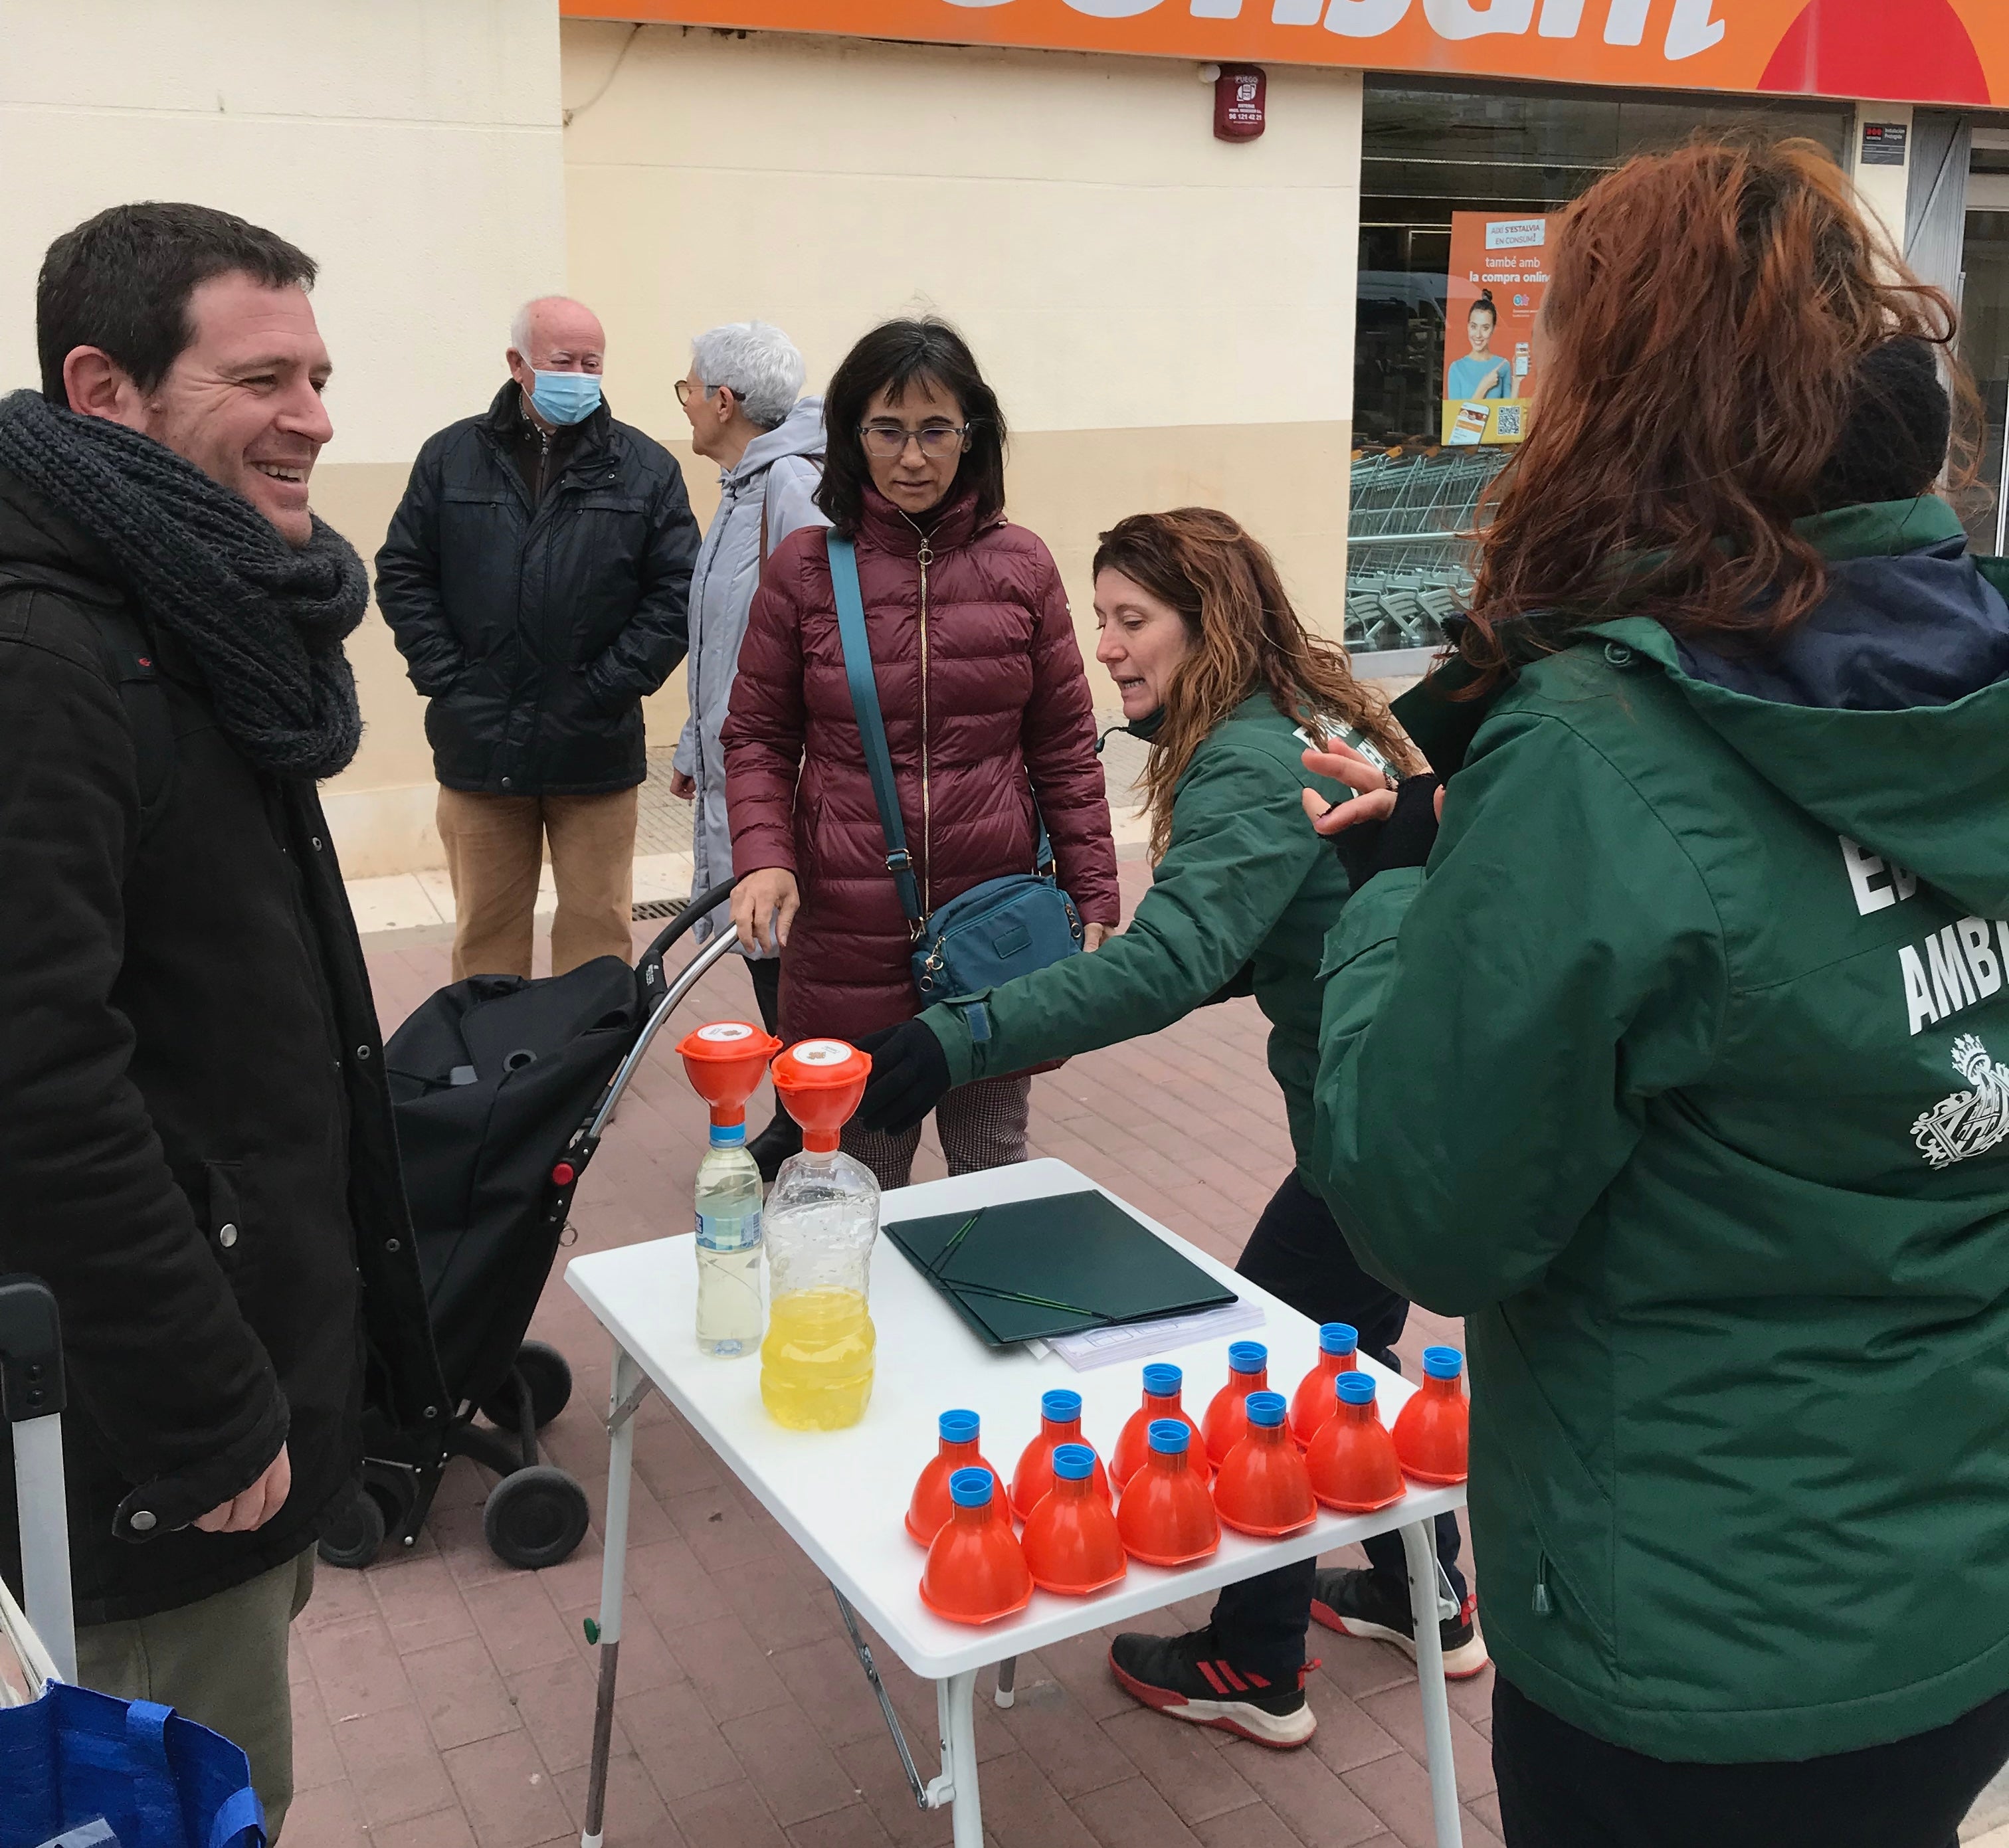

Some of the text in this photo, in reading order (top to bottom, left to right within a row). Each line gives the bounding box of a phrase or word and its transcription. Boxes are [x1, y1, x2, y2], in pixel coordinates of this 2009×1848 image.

[1485, 256, 1541, 268] també amb
[1470, 270, 1479, 282] la
[1482, 274, 1521, 285] compra
